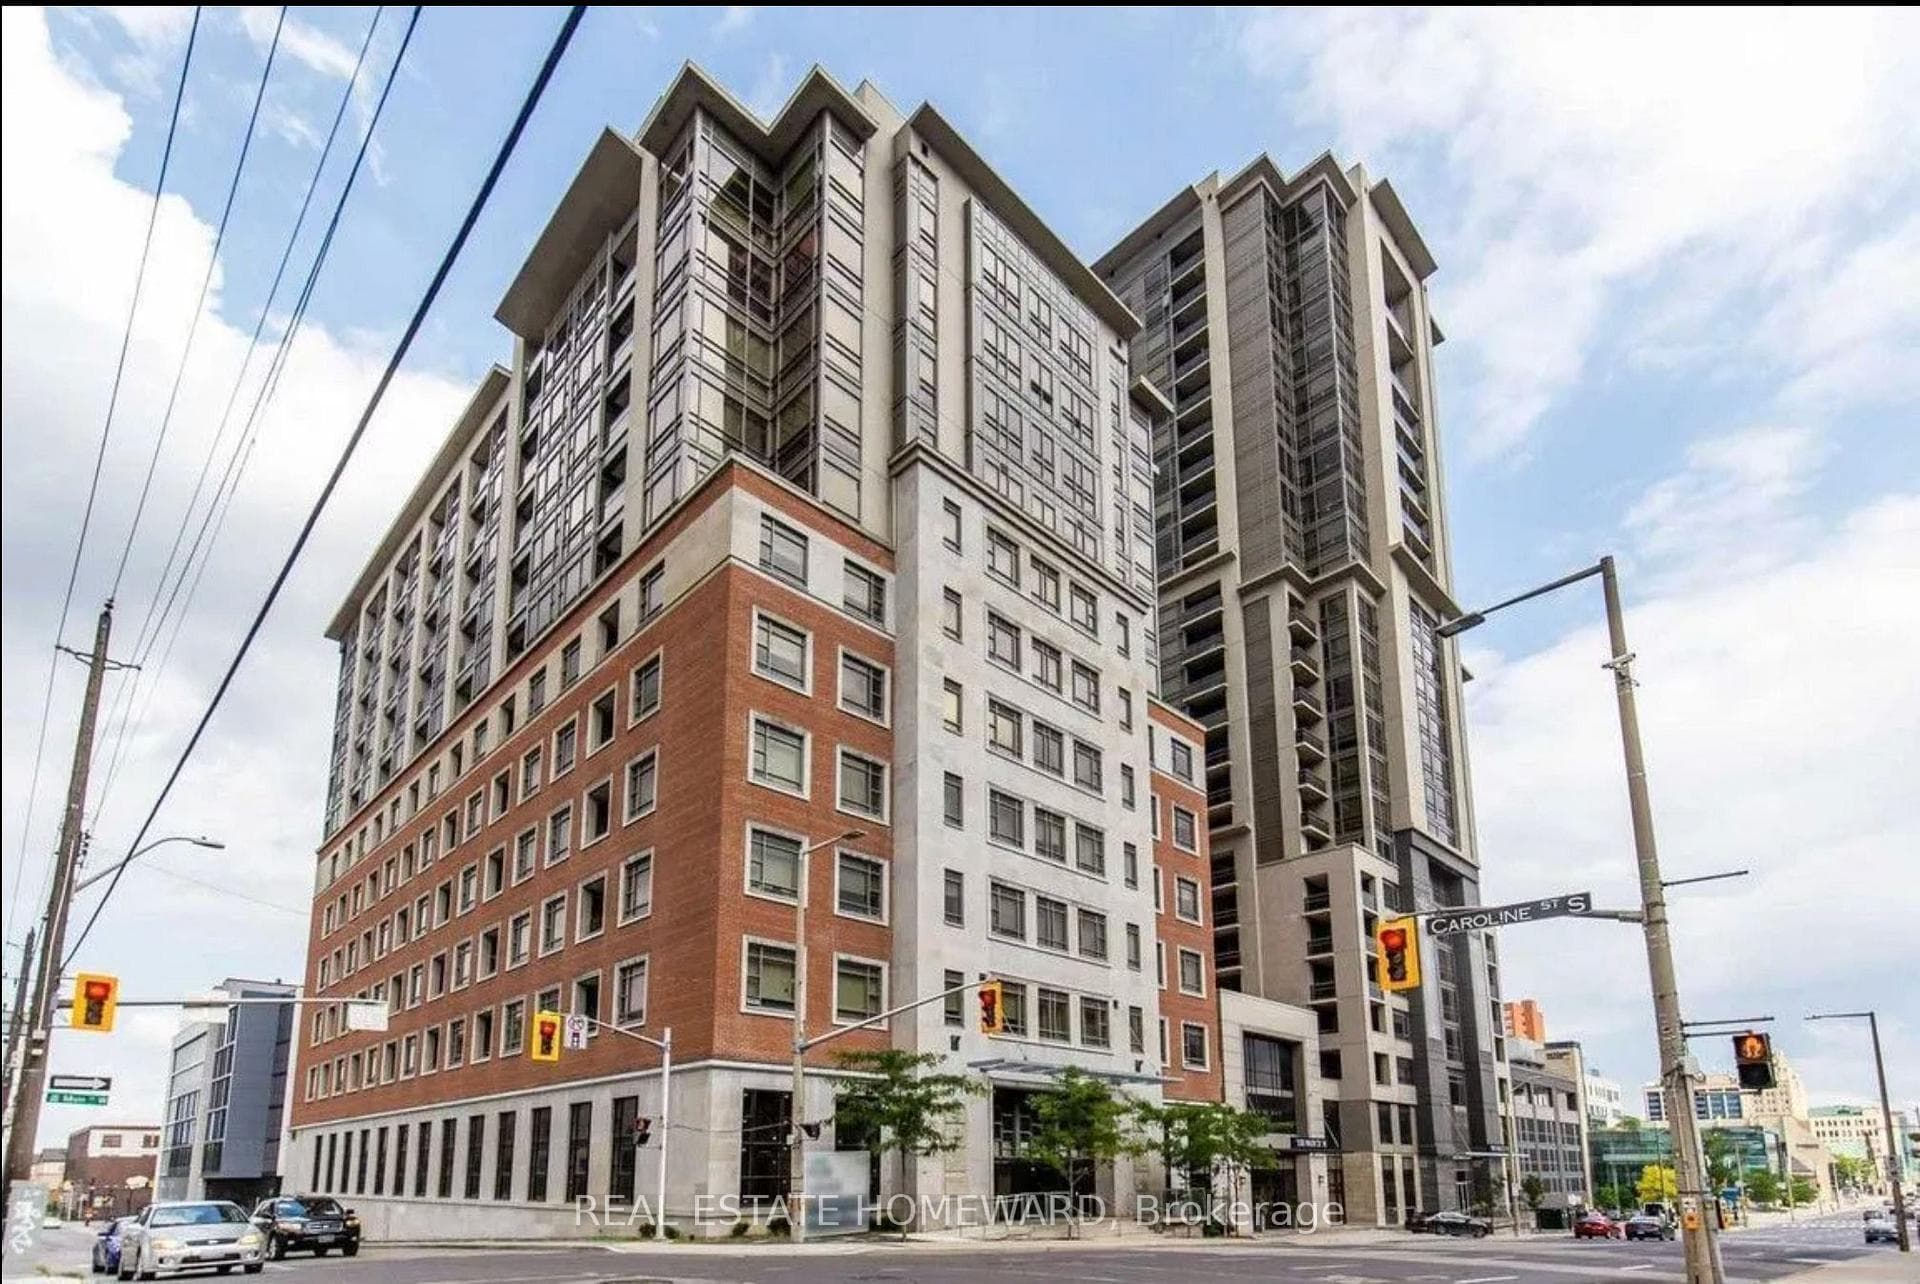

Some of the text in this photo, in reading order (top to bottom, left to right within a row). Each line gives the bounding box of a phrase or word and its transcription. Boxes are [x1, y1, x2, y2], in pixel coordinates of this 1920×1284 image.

[1431, 896, 1586, 934] CAROLINE ST S
